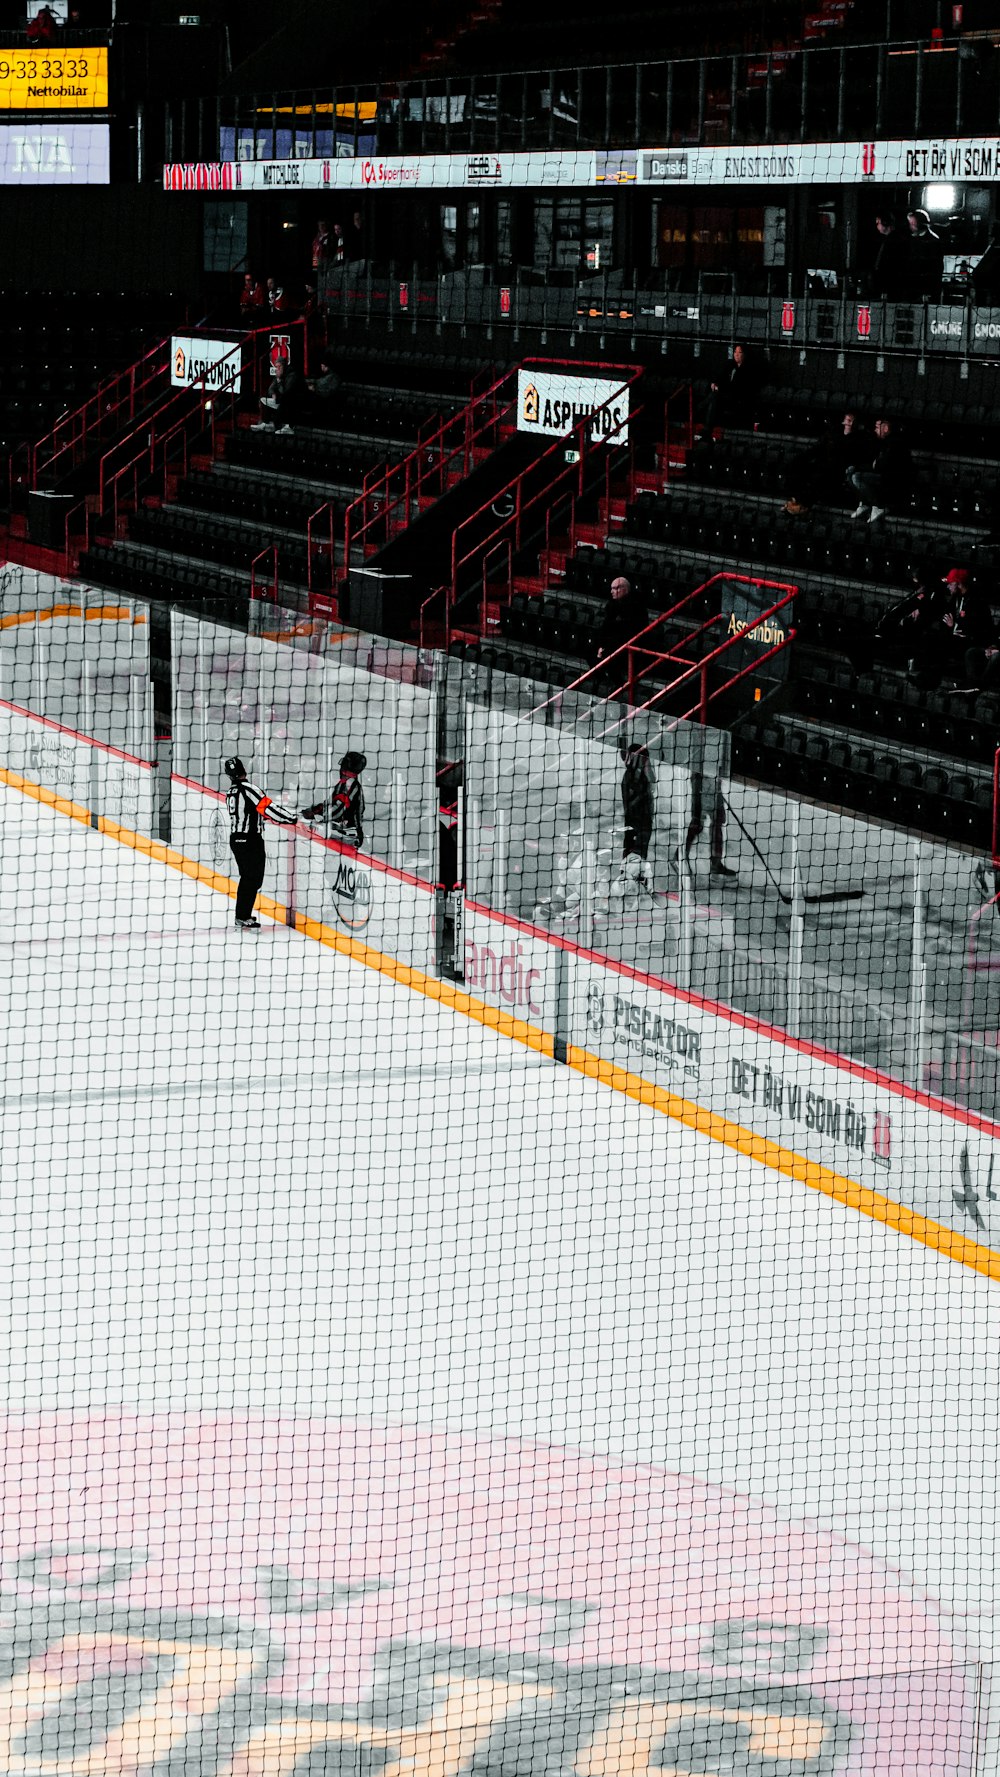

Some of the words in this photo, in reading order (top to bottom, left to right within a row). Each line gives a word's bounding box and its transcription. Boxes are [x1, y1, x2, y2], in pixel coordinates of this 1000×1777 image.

[41, 60, 63, 79] 33
[66, 59, 89, 79] 33
[27, 85, 89, 97] Nettobilar
[652, 159, 687, 176] Danske
[724, 152, 795, 178] ENGSTRÖMS
[906, 149, 927, 176] DET
[931, 144, 947, 177] ÄR
[950, 148, 961, 176] VI
[965, 148, 992, 175] SOM
[373, 501, 379, 512] 5
[261, 587, 267, 597] 3
[613, 995, 701, 1063] PISCATOR
[613, 1031, 679, 1070] ventilation
[684, 1065, 700, 1079] ab
[731, 1056, 760, 1103] DET
[763, 1064, 783, 1115] ÄR
[787, 1080, 802, 1124] VI
[805, 1090, 841, 1142] SOM
[844, 1100, 867, 1154] ÄR
